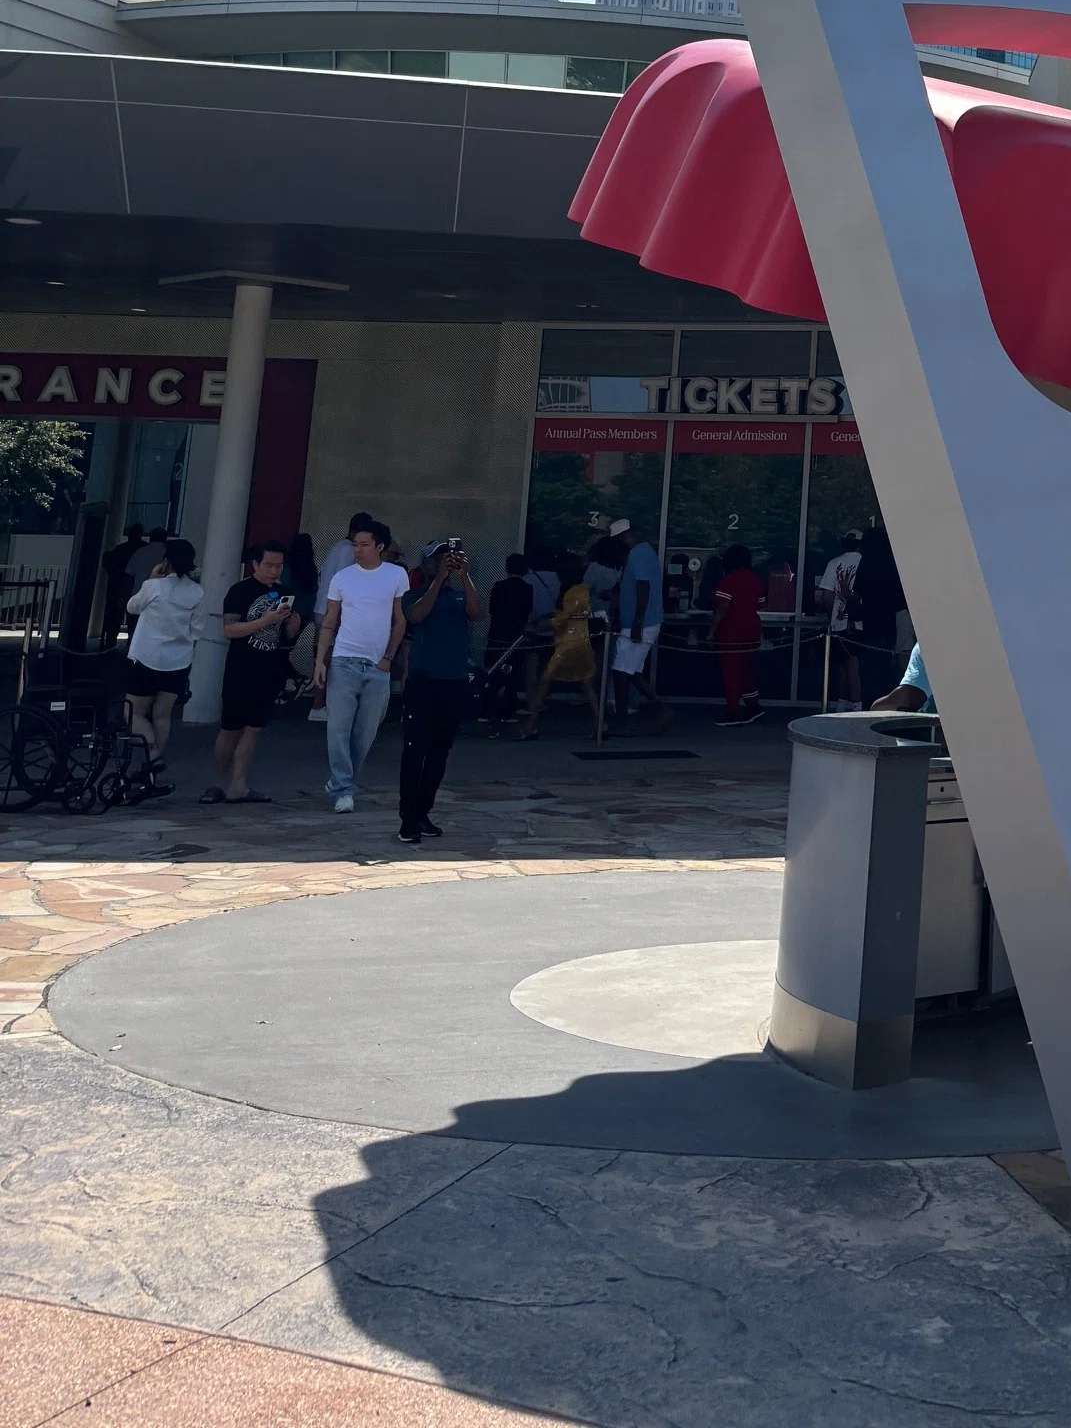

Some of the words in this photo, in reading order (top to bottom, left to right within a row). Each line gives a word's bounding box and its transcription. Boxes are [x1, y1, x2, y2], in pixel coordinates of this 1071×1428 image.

[0, 364, 227, 406] RANCE
[639, 376, 843, 415] TICKETS
[544, 427, 582, 439] Annual
[583, 428, 607, 439] Pass
[608, 428, 658, 441] Members
[691, 429, 733, 441] General
[734, 429, 788, 442] Admission
[587, 511, 600, 527] 3
[728, 514, 740, 530] 2
